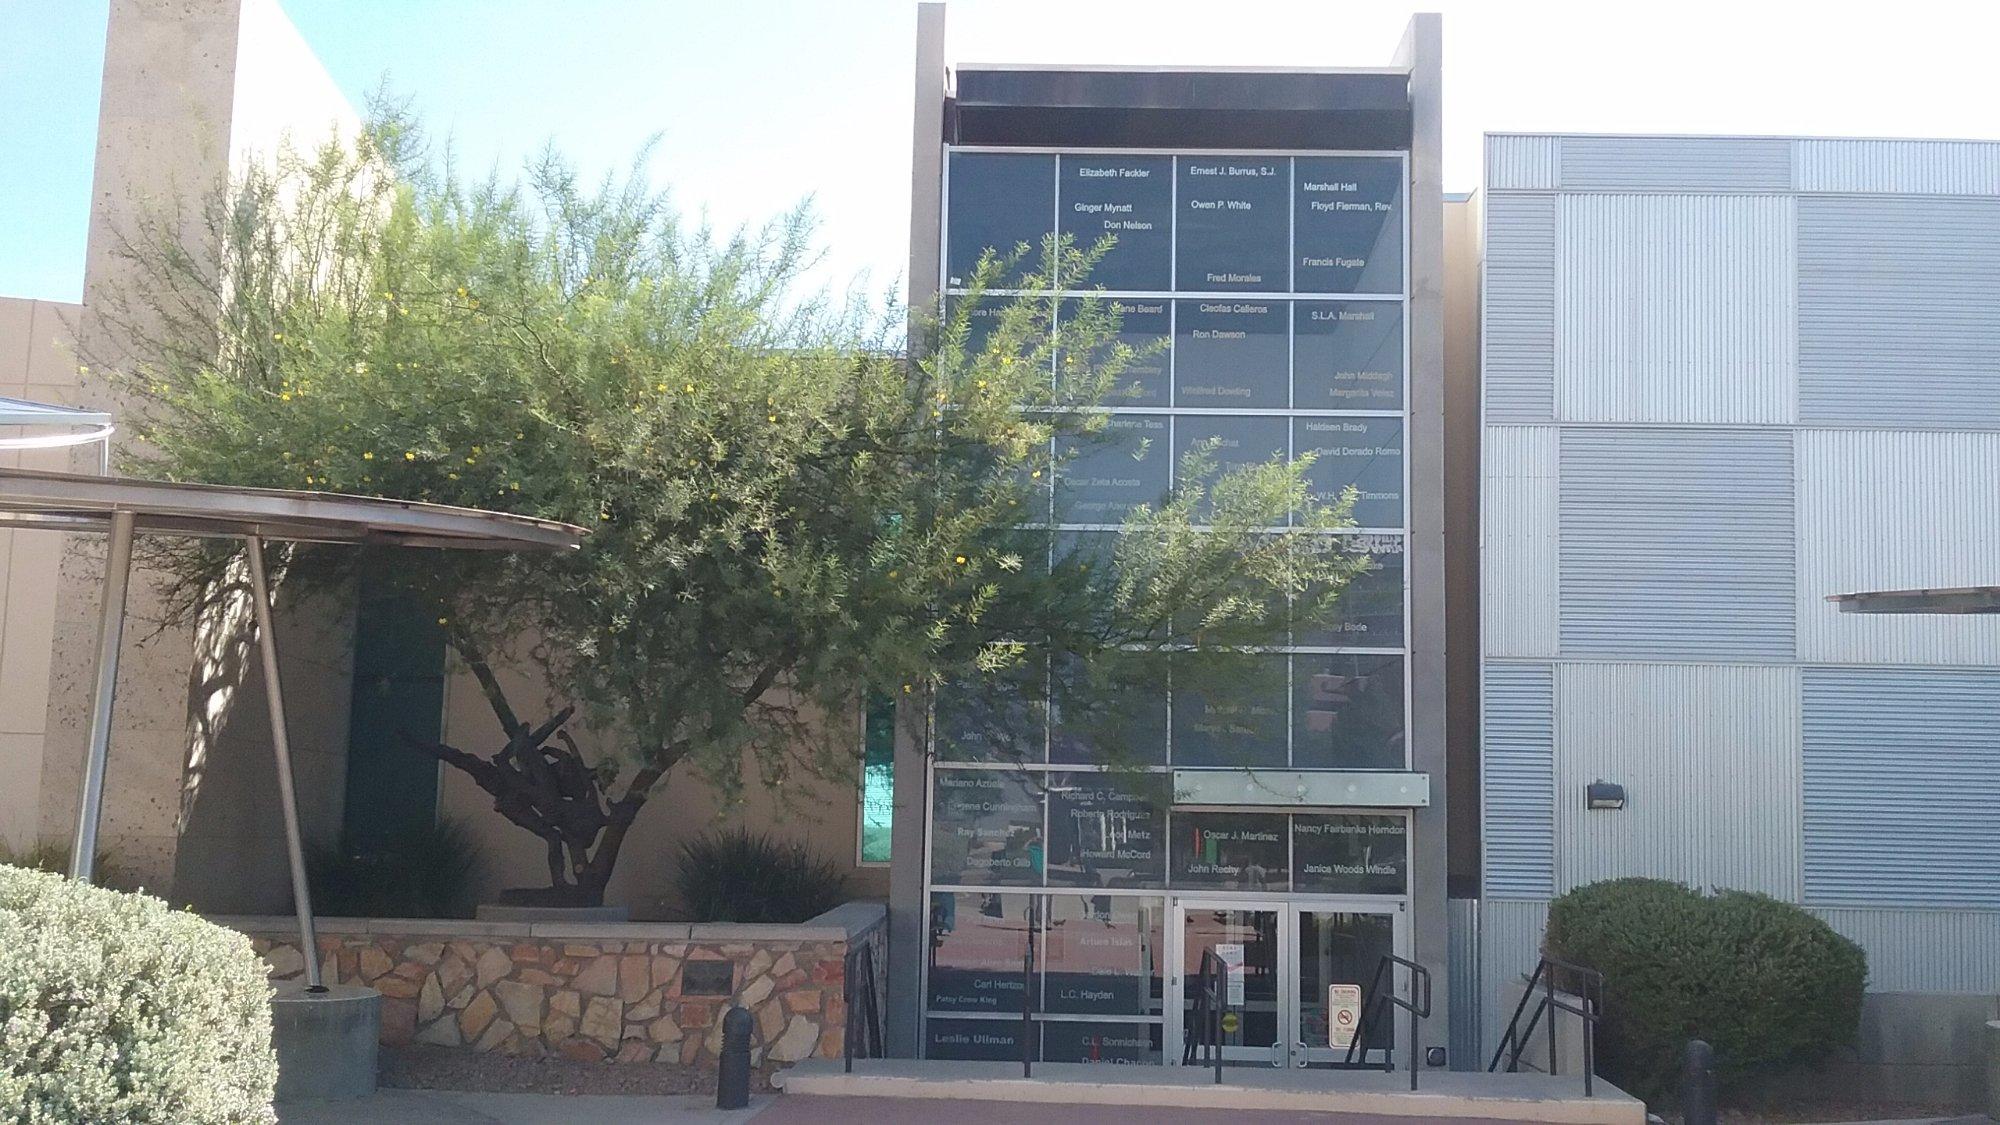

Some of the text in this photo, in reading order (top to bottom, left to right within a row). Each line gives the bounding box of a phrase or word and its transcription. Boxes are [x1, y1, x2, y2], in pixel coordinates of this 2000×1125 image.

[1079, 168, 1150, 178] Elizabeth Fackler
[1191, 167, 1276, 177] Ernest J. Burrus, S.J.
[1304, 183, 1357, 192] Marshall Hall
[1075, 202, 1132, 213] Ginger Mynatt
[1191, 201, 1215, 209] Owen
[1227, 201, 1251, 210] White
[1312, 202, 1334, 211] Floyd
[1336, 202, 1372, 212] Fierman,
[1104, 221, 1152, 230] Don Nelson
[1303, 257, 1365, 268] Francis Fugate
[1207, 274, 1261, 283] Fred Morales
[1137, 305, 1163, 314] Beard
[1312, 312, 1337, 320] S.L.A.
[1193, 330, 1246, 339] Ron Dawson
[1342, 447, 1373, 456] Dorado
[1375, 447, 1400, 456] Romo
[1061, 791, 1094, 801] Richard
[1295, 824, 1322, 834] Nancy
[1127, 831, 1150, 839] Metz
[1203, 830, 1228, 840] Oscar
[1231, 831, 1239, 840] J.
[1117, 850, 1151, 859] McCord
[1188, 864, 1239, 876] John Rechy
[1304, 864, 1331, 874] Janice
[1334, 864, 1364, 874] Woods
[974, 979, 992, 989] Carl
[1060, 990, 1114, 1001] L.C. Hayden
[935, 1034, 1014, 1045] Leslie Ullman
